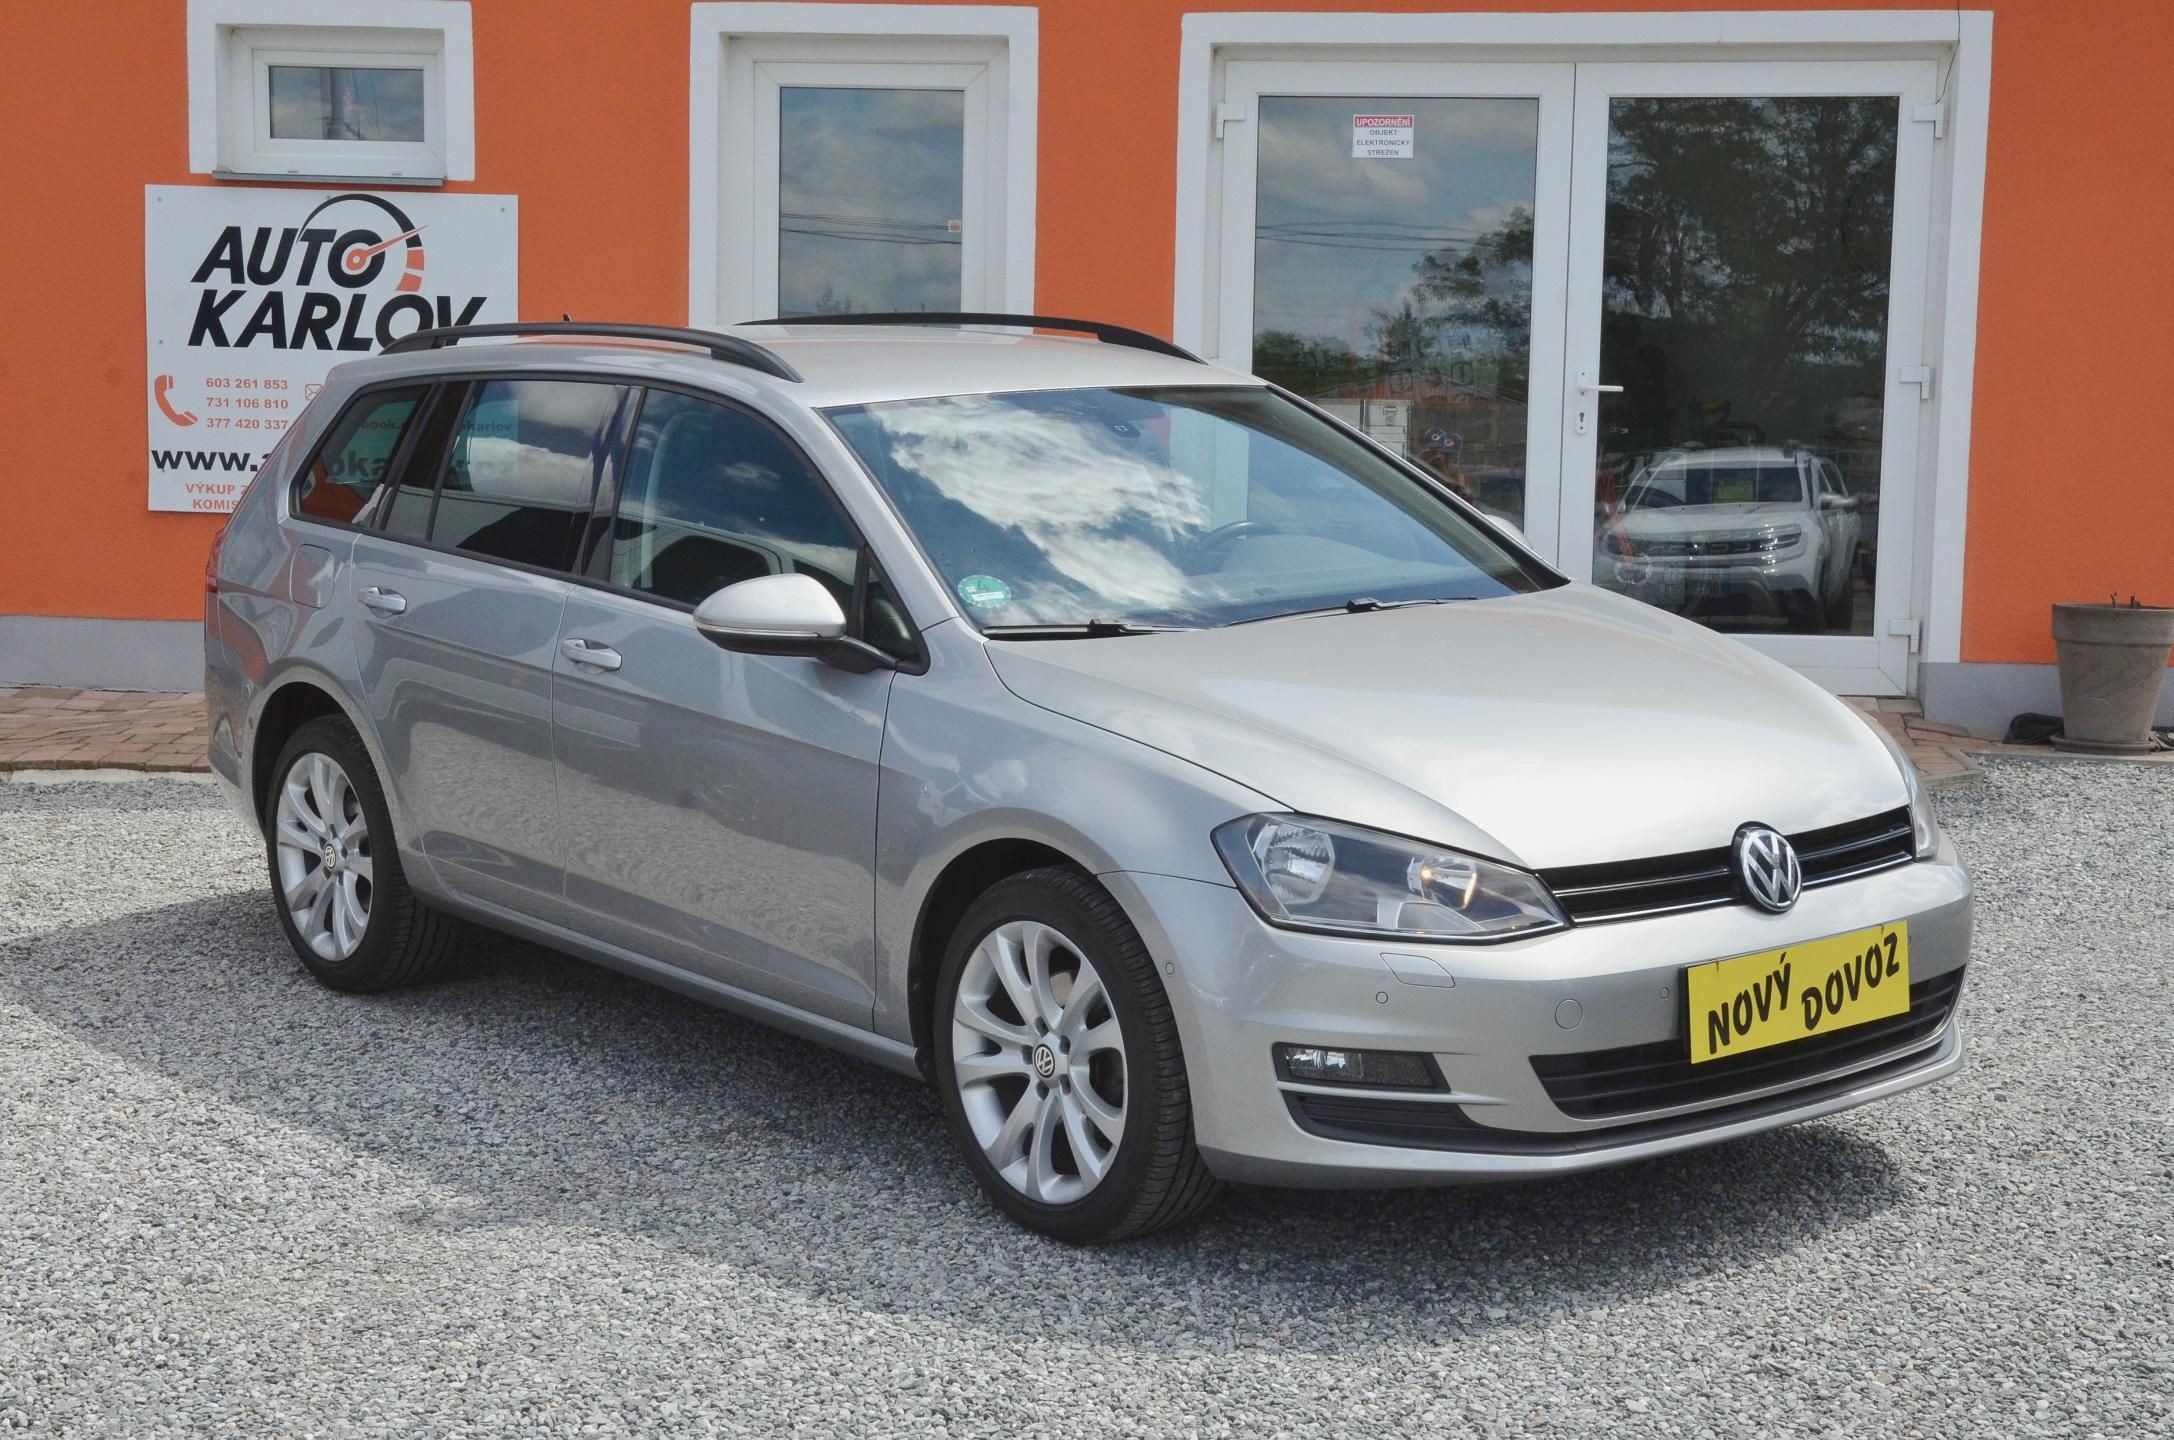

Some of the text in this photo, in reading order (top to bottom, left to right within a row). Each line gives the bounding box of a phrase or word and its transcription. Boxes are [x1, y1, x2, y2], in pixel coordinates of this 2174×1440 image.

[1356, 117, 1411, 127] UPOZORNĚNÍ
[190, 225, 386, 289] AUTO
[188, 289, 488, 352] KARLOV
[206, 377, 289, 390] 603 261 853
[206, 397, 289, 410] 731 106 810
[207, 417, 289, 430] 377 420 337
[184, 481, 236, 495] VÝKUP
[1708, 931, 1900, 1055] NOVÝ DOVOZ
